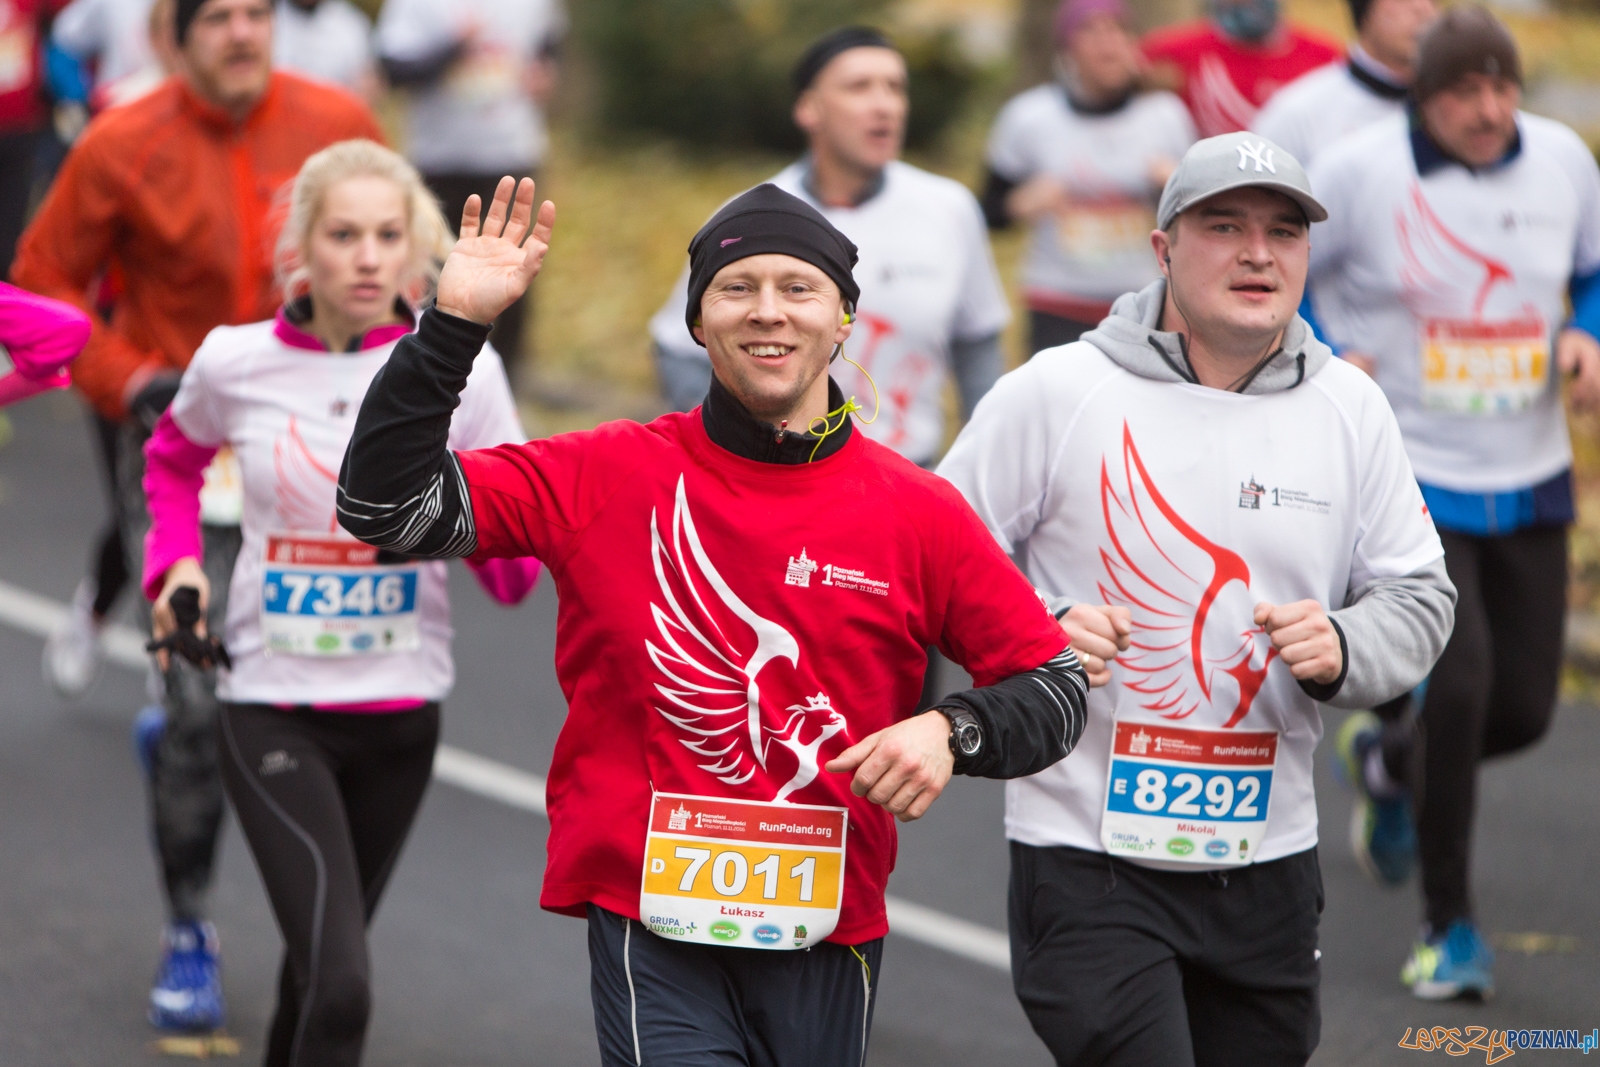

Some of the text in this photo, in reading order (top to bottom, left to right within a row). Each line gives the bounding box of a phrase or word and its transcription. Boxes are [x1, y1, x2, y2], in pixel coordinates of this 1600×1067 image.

[1236, 139, 1276, 175] NY
[822, 564, 834, 586] 1
[281, 574, 405, 616] 7346
[1213, 745, 1270, 757] RunPoland.org
[1113, 769, 1261, 817] E 8292
[694, 812, 703, 828] 1
[759, 821, 832, 838] RunPoland.org
[1177, 823, 1217, 836] Mikołaj
[1111, 832, 1140, 843] GRUPA
[1110, 840, 1145, 852] LUXMED
[650, 846, 817, 902] D 7011
[720, 905, 765, 918] Łukasz
[649, 916, 680, 927] GRUPA
[649, 923, 685, 936] LUXMED
